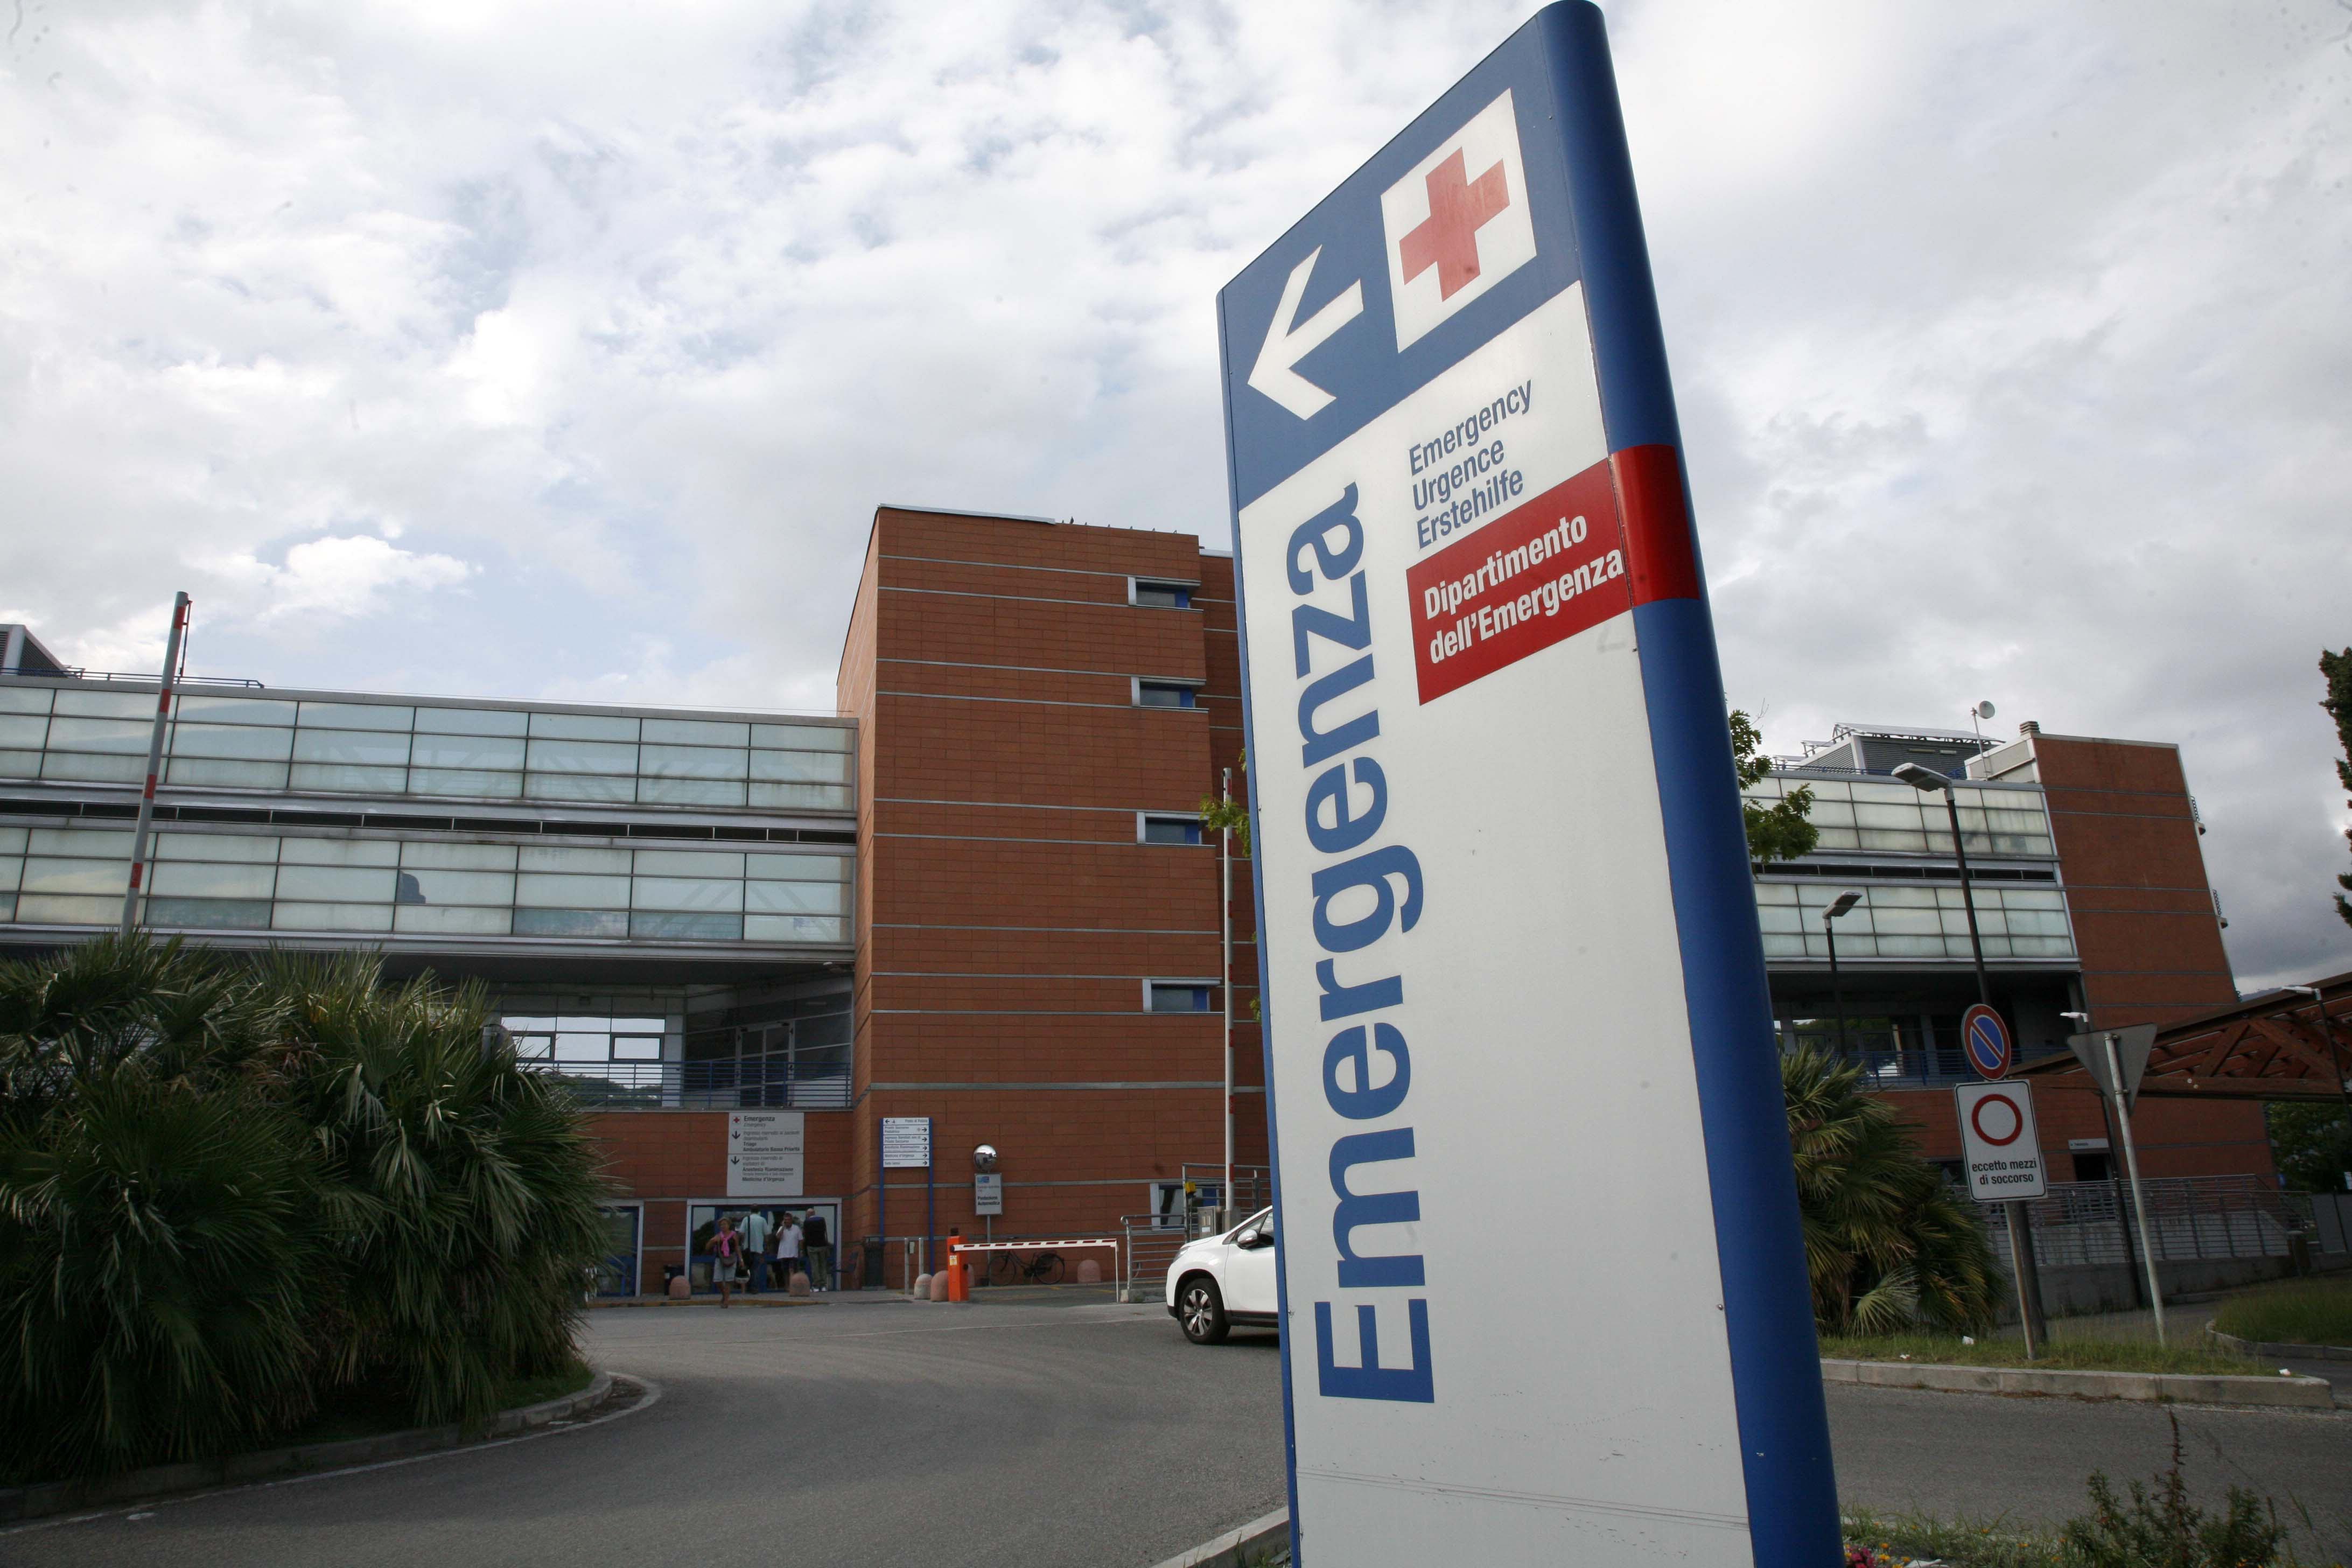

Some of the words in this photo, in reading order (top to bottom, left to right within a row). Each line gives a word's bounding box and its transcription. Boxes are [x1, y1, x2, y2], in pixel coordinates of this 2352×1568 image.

[1409, 380, 1532, 477] Emergency
[1412, 438, 1504, 512] Urgence
[1416, 470, 1523, 550] Erstehilfe
[1424, 515, 1587, 620] Dipartimento
[1430, 549, 1625, 664] dell'Emergenza
[1286, 481, 1434, 1403] Emergenza
[1972, 1160, 2007, 1172] eccetto
[2010, 1158, 2037, 1170] mezzi
[1979, 1174, 1988, 1185] di
[1991, 1173, 2034, 1184] soccorso
